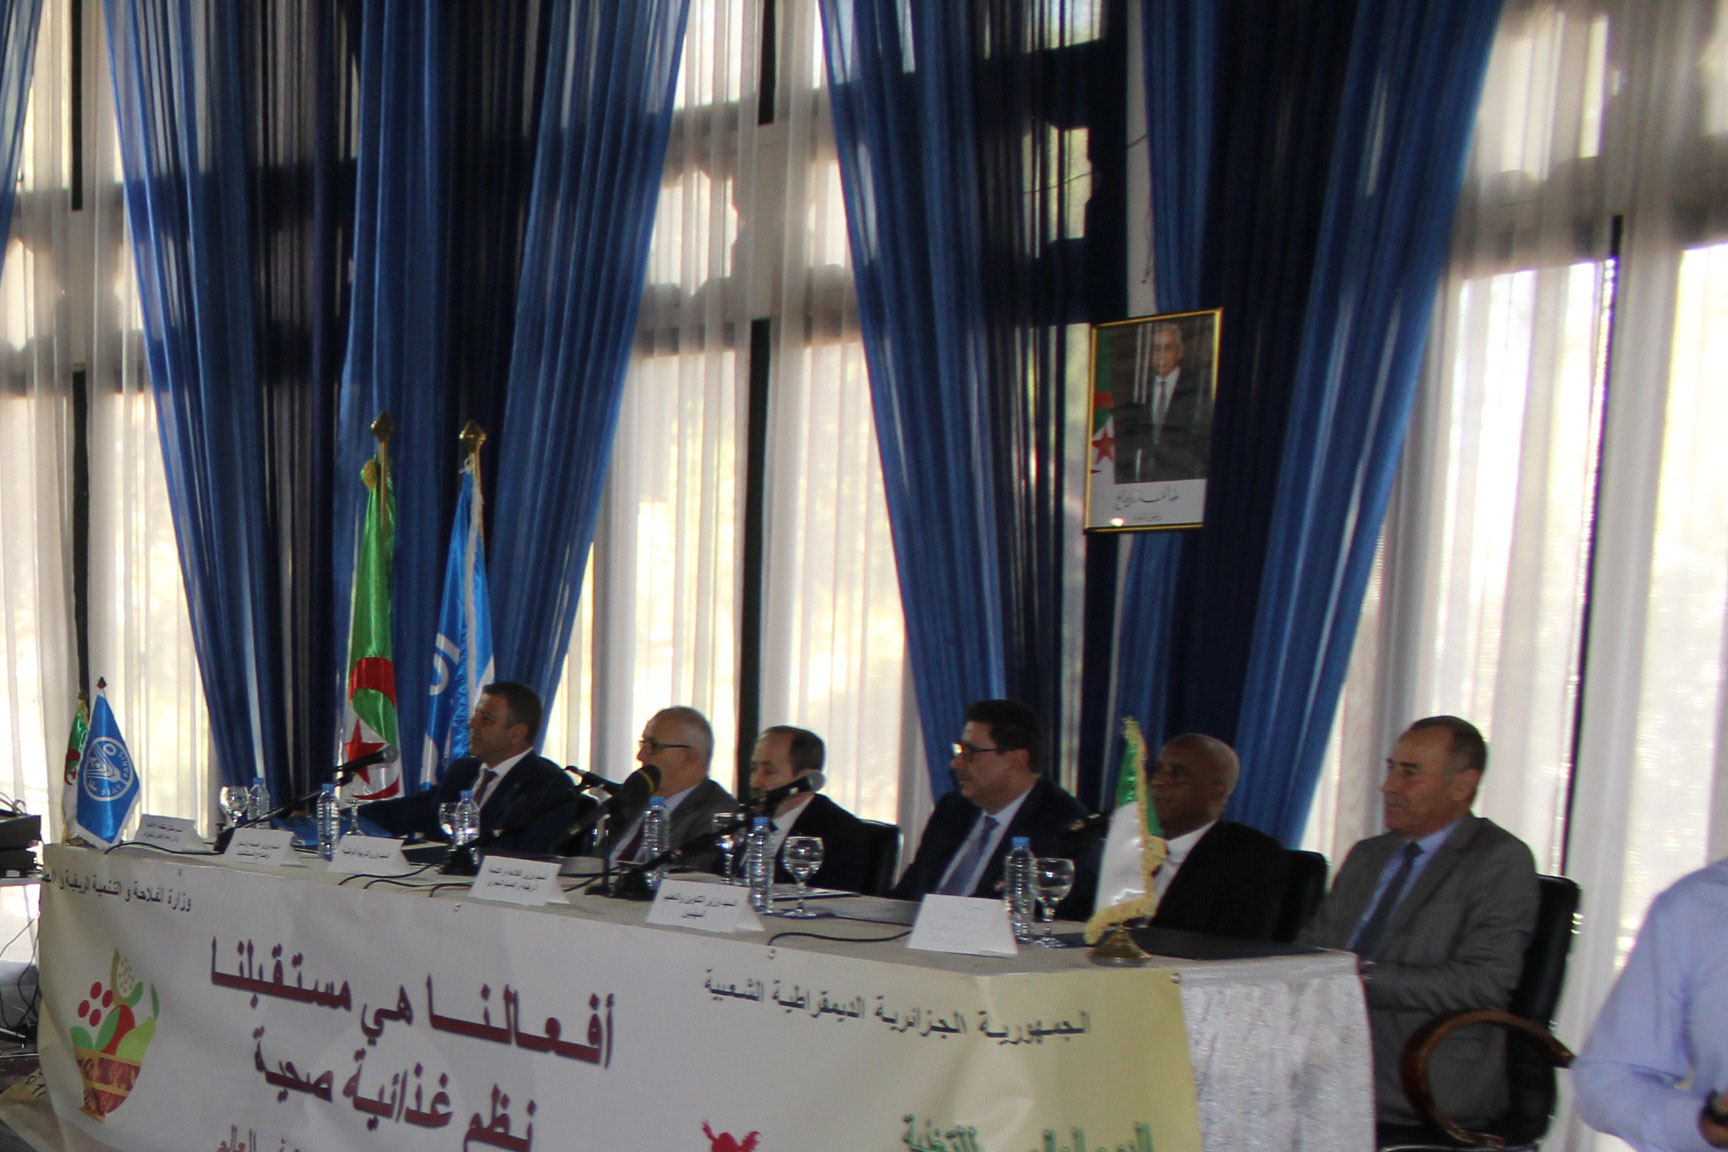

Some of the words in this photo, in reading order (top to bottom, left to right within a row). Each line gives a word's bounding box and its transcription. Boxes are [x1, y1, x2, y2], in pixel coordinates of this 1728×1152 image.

[92, 874, 122, 898] التنمية
[133, 880, 165, 902] الفلاحة
[167, 887, 191, 912] وزارة
[210, 935, 353, 1013] مستقبلنا
[704, 968, 764, 1002] الشعبية
[361, 984, 414, 1045] هي
[426, 972, 615, 1069] أفعالنا
[771, 979, 866, 1023] الديمقراطية
[874, 996, 967, 1039] الجزائرية
[978, 1009, 1091, 1045] الجمهورية
[252, 1025, 334, 1103] صحية
[342, 1047, 455, 1131] غذائية
